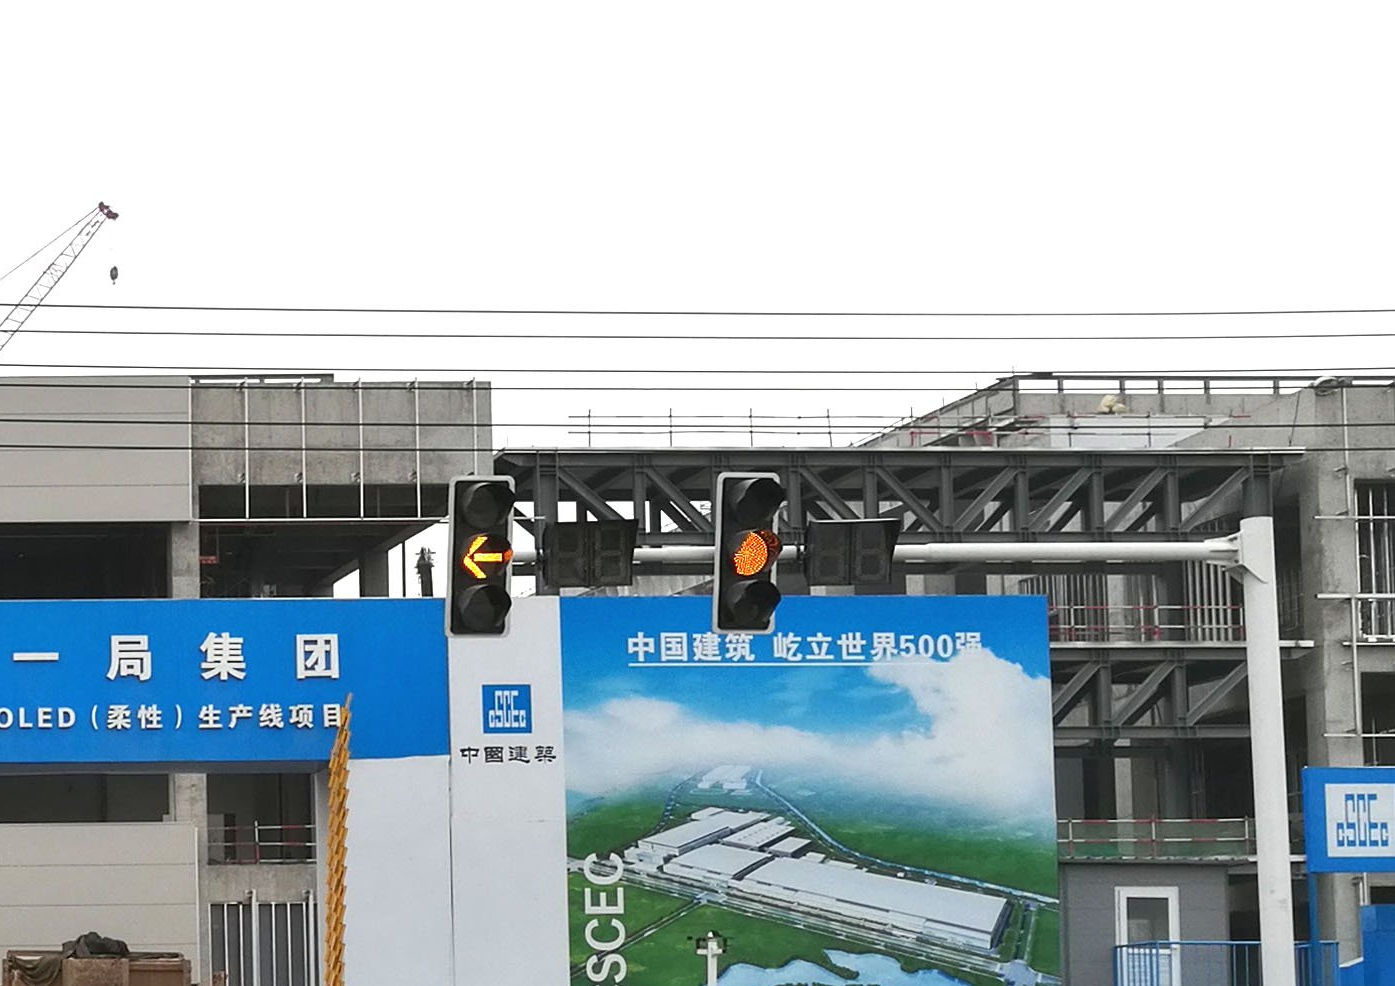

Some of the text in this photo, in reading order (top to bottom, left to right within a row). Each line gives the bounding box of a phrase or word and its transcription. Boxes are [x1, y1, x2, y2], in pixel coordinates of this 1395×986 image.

[628, 631, 983, 662] 中国建筑 屹立世界500强
